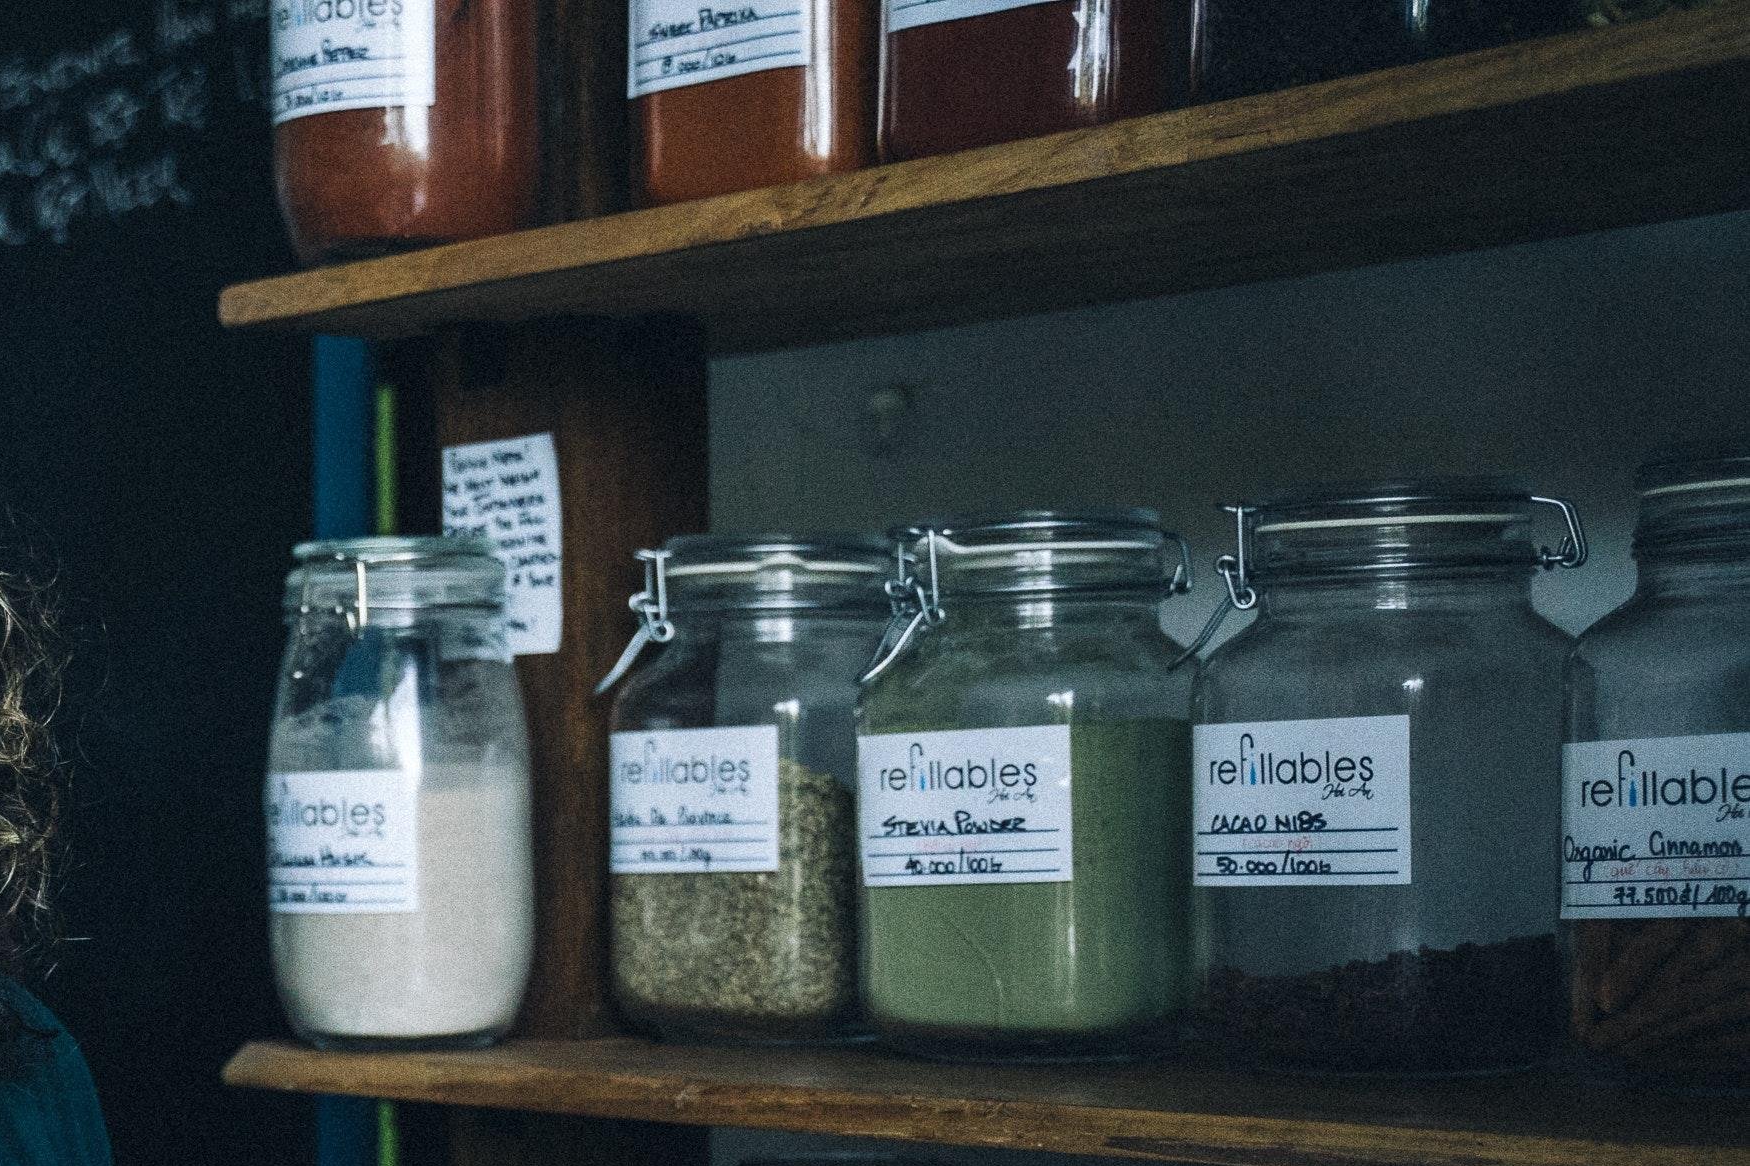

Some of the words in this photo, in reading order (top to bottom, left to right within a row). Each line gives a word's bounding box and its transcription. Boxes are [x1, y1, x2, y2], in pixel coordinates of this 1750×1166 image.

[880, 742, 1038, 791] refillables
[1210, 734, 1375, 785] refillables
[1581, 750, 1750, 807] refillable
[882, 815, 950, 837] STEVIA
[954, 810, 1027, 835] POWDER
[1211, 814, 1267, 834] CACAO
[1275, 811, 1327, 832] NIBS
[1563, 835, 1636, 882] Organic
